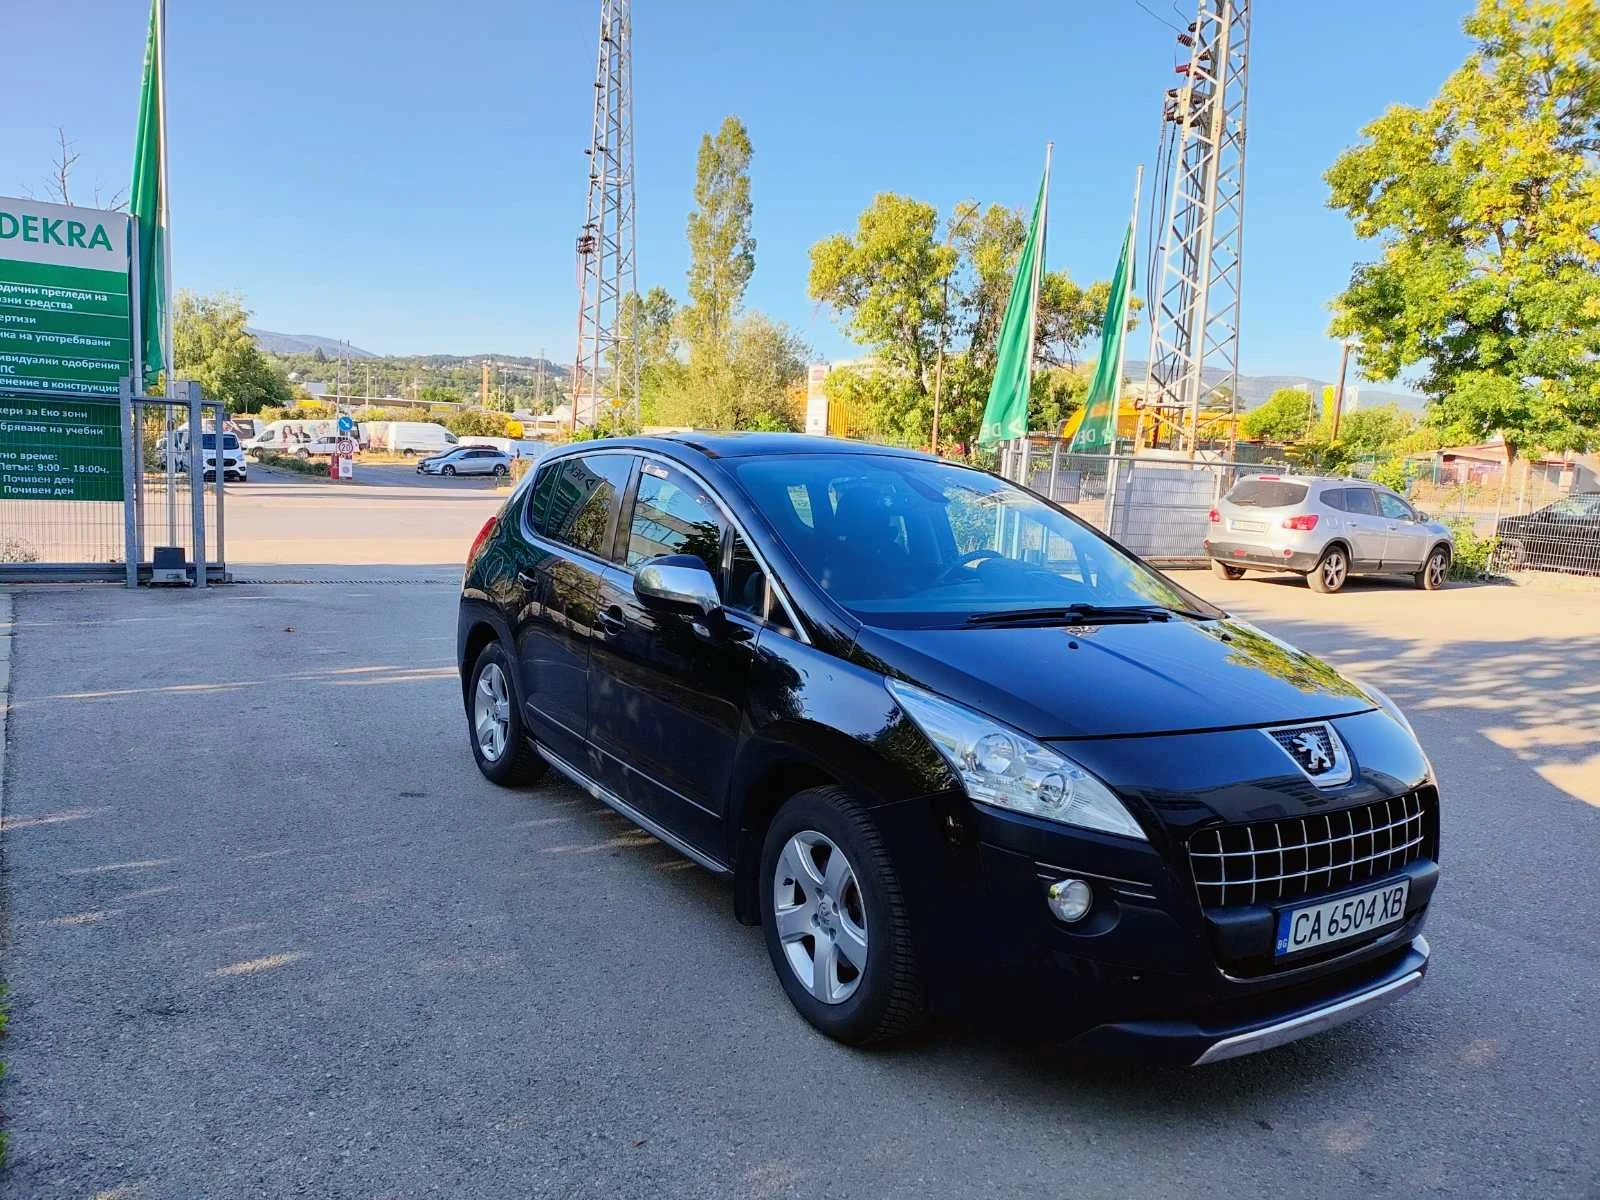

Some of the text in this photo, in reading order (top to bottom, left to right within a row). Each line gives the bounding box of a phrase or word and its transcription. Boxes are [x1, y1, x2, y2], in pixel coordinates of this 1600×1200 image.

[0, 212, 113, 251] DEKRA
[41, 288, 92, 301] прегледи
[94, 294, 108, 302] на
[0, 296, 73, 310] зни средства
[19, 333, 32, 341] на
[34, 334, 111, 347] употребявани
[61, 359, 120, 370] одобрения
[51, 382, 120, 393] конструкция
[40, 408, 60, 417] Еко
[62, 410, 88, 419] зони
[0, 422, 104, 436] бряване на учебни
[20, 452, 58, 462] време:
[37, 463, 60, 472] 9:00
[73, 464, 110, 474] 18:00ч.
[3, 474, 75, 485] Почивен ден
[3, 485, 74, 496] Почивен ден
[1327, 894, 1378, 937] 6504
[1276, 938, 1288, 950] BG
